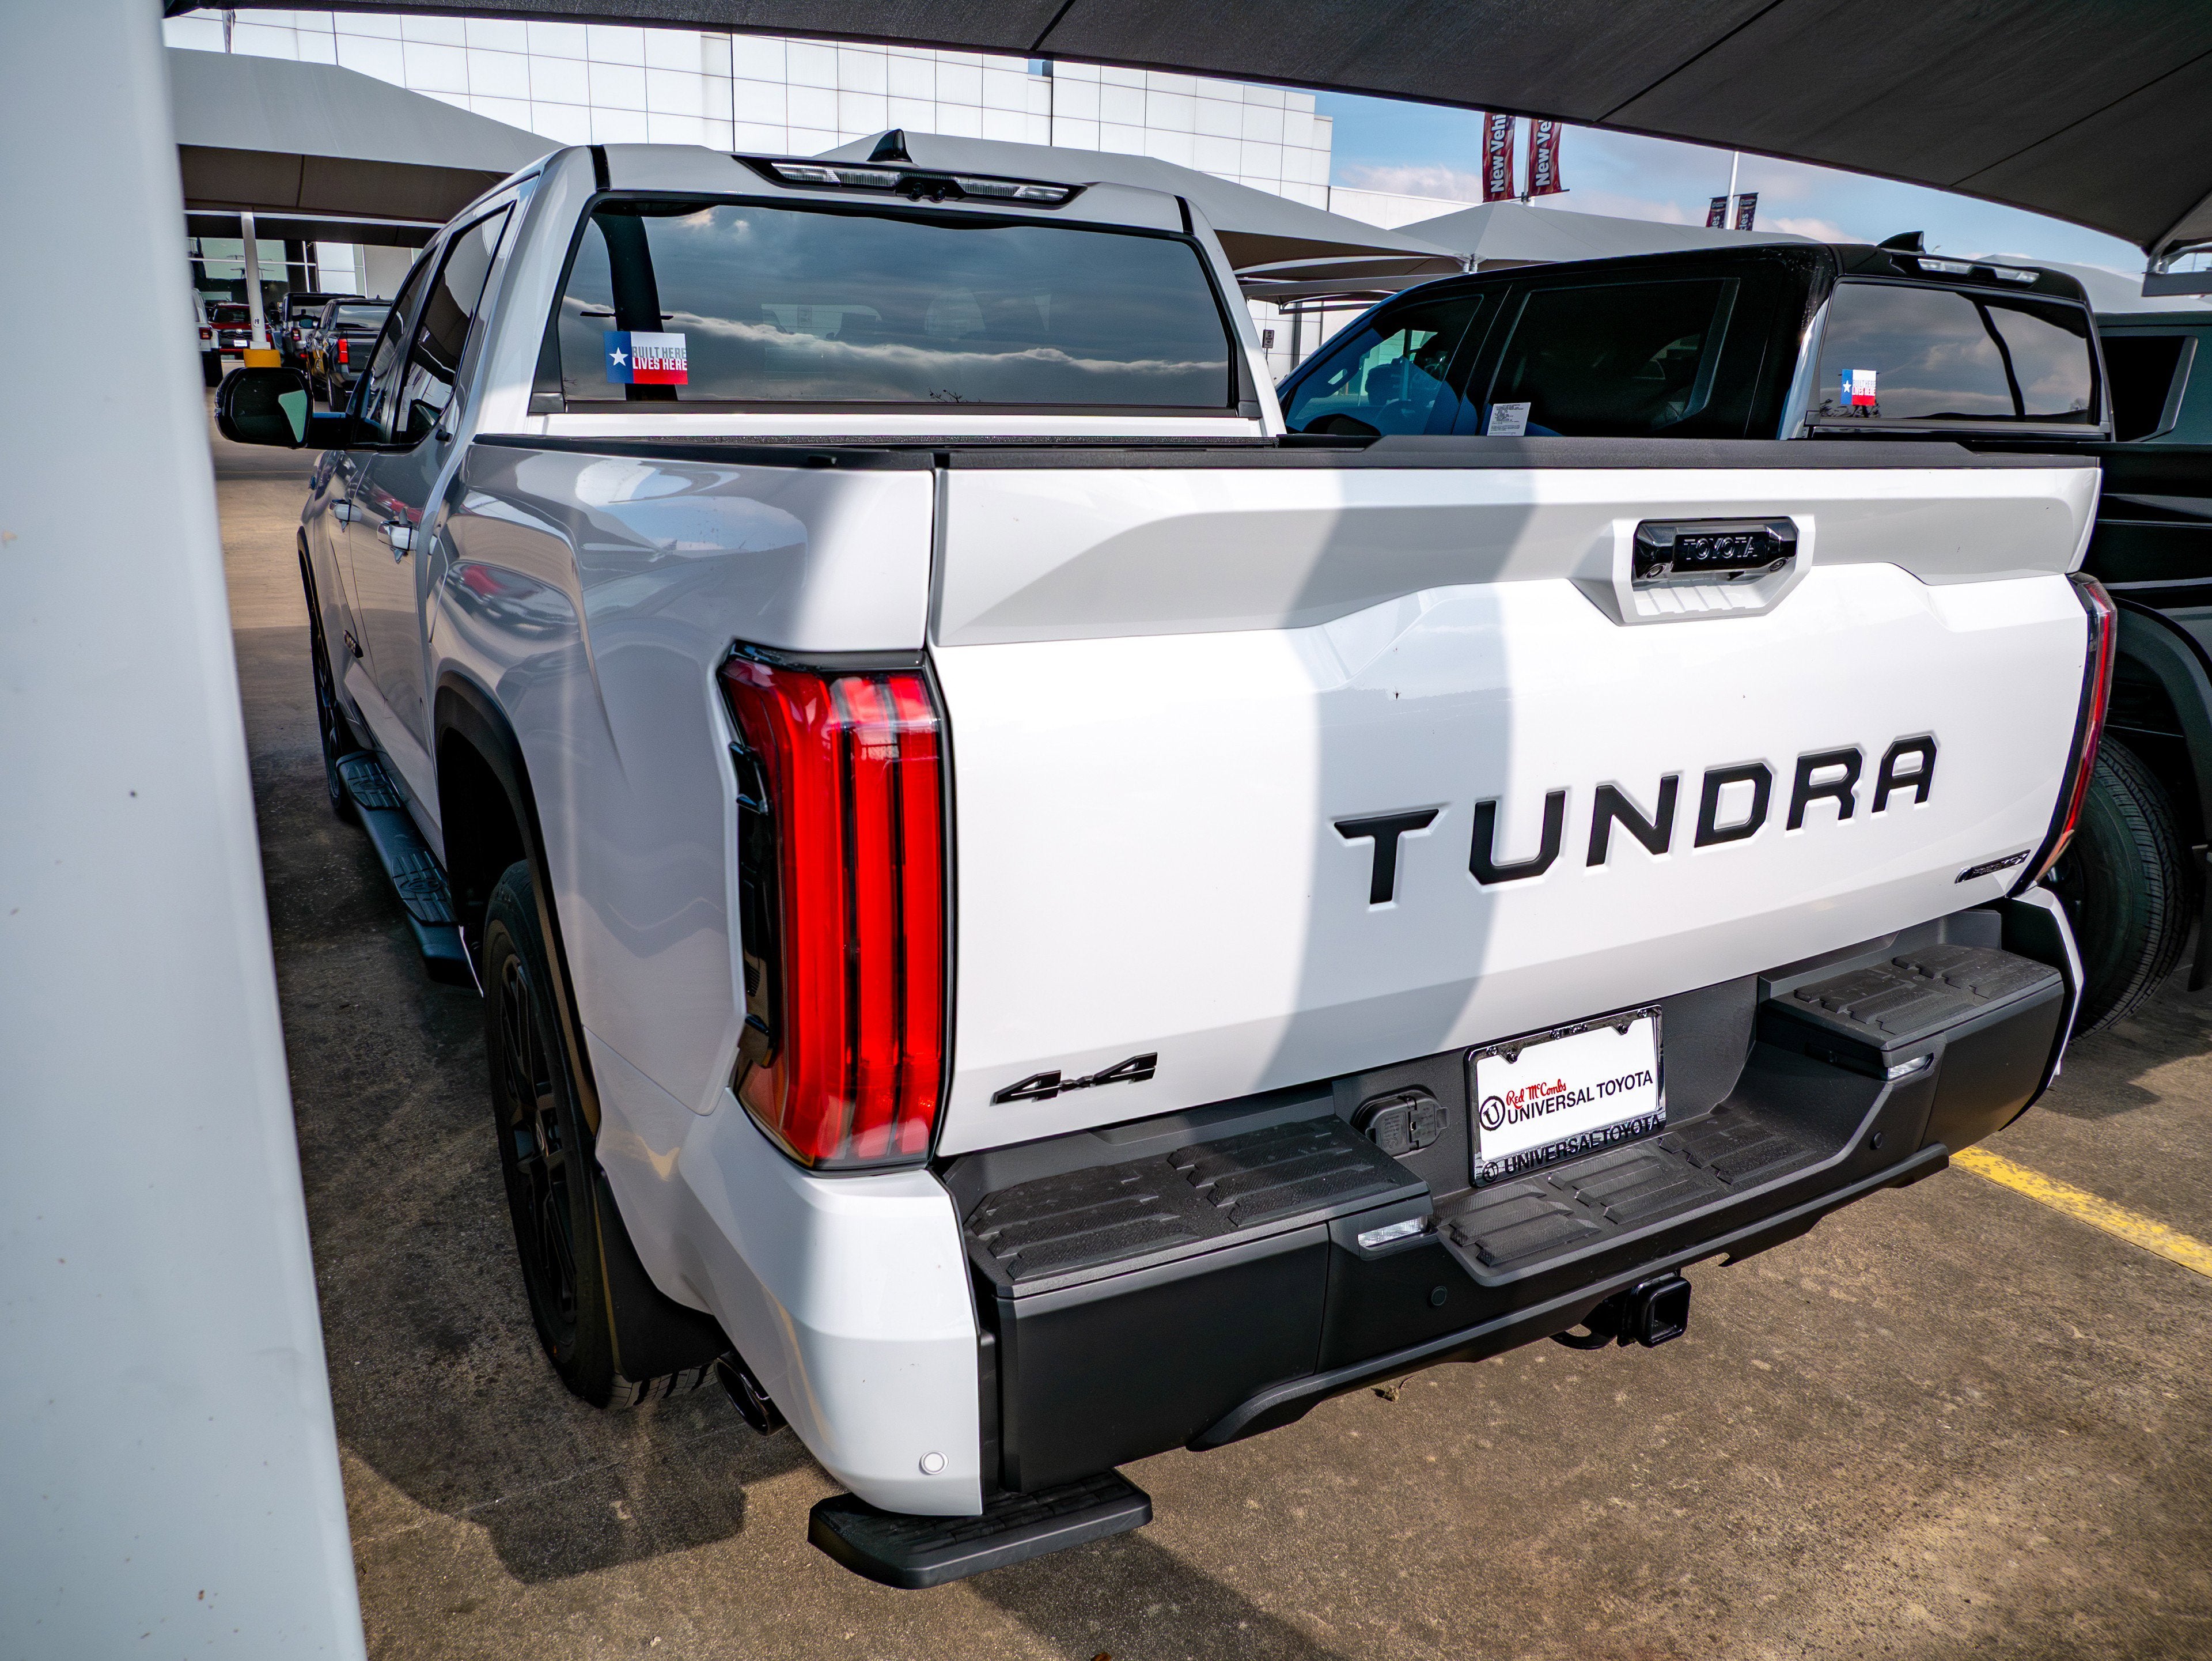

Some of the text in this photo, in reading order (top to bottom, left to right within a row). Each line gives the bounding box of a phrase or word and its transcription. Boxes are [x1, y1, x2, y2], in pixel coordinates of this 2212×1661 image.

[1491, 156, 1505, 192] New
[1536, 148, 1551, 187] New
[632, 346, 687, 360] BUILT HERE
[632, 357, 688, 370] LIVES HERE
[1683, 536, 1758, 561] TOYOTA
[1333, 734, 1938, 906] TUNDRA
[1506, 1078, 1567, 1110] Red McCombs
[1507, 1069, 1653, 1125] UNIVERSAL TOYOTA
[1504, 1114, 1662, 1174] UNIVERSAL TOYOTA
